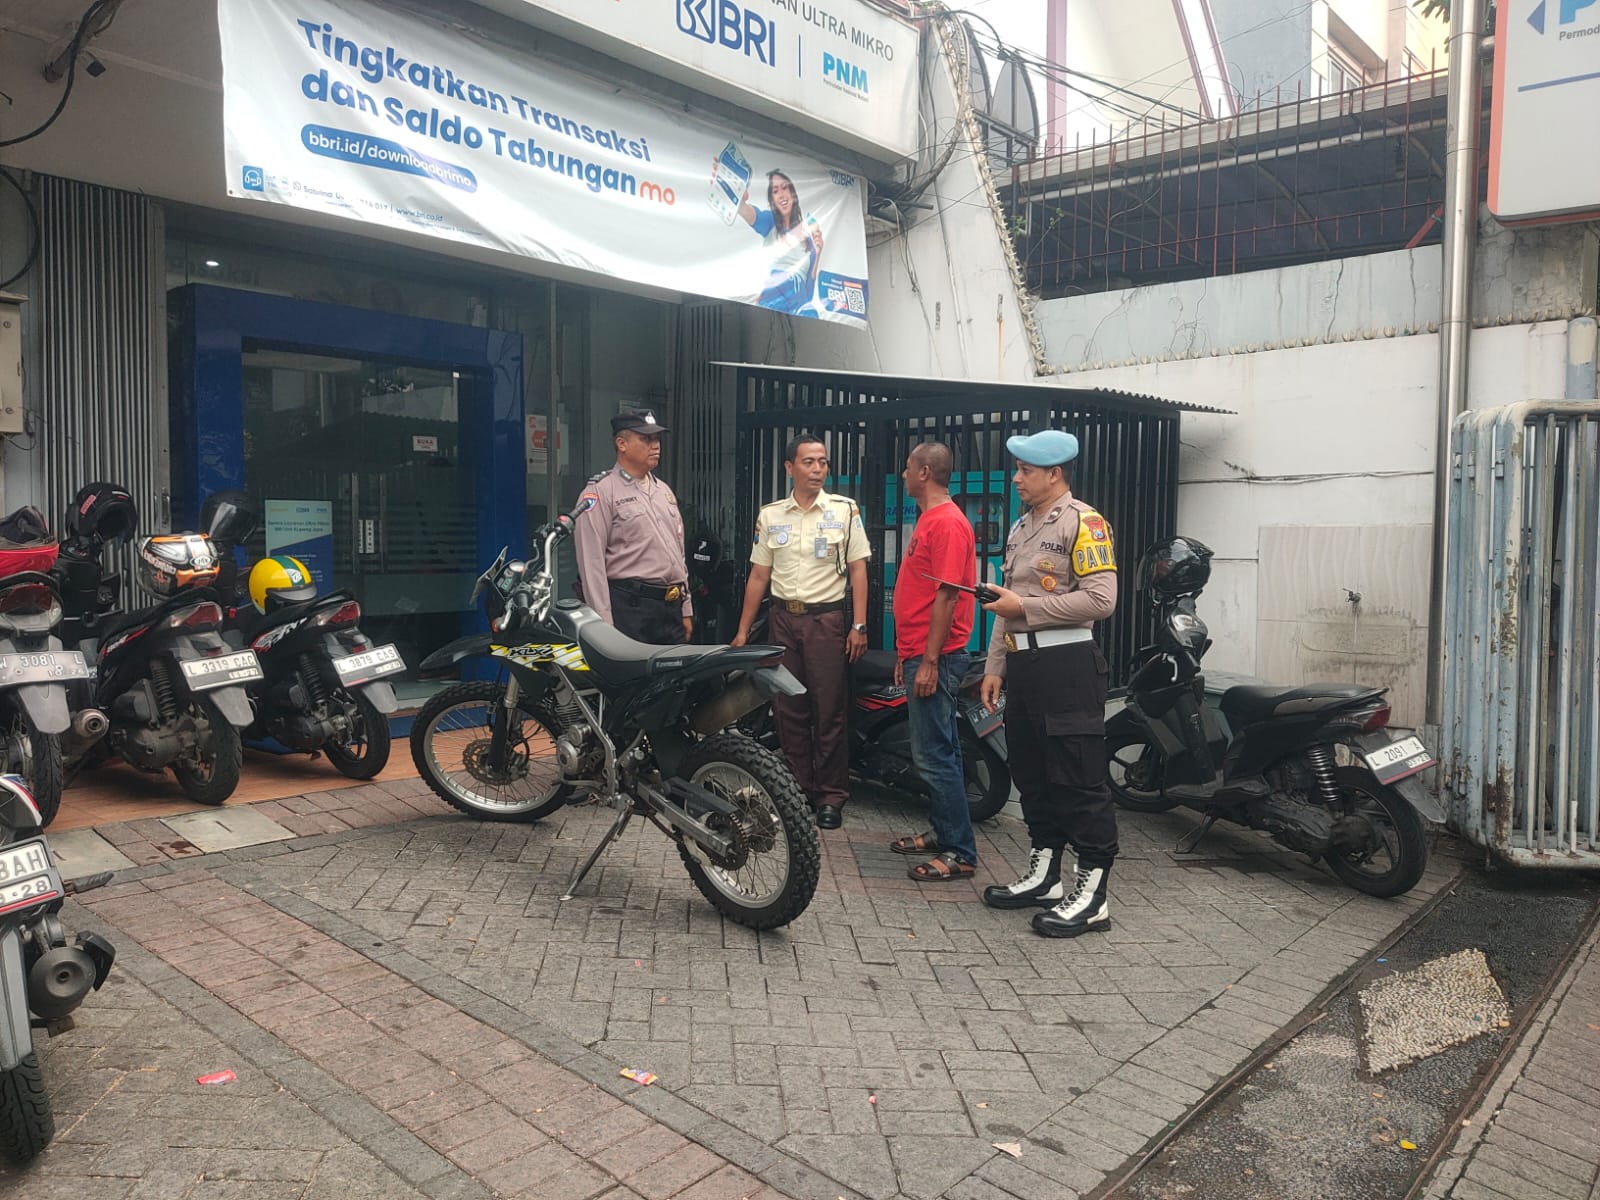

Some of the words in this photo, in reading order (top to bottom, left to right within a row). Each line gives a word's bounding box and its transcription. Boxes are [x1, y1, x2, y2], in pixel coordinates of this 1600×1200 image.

[719, 0, 776, 68] BRI
[803, 2, 847, 40] ULTRA
[851, 27, 894, 62] MIKRO
[823, 51, 869, 94] PNM
[297, 18, 510, 115] Tingkatkan
[511, 95, 652, 162] Transaksi
[301, 69, 378, 119] dan
[385, 97, 483, 150] Saldo
[489, 127, 637, 197] Tabungan
[640, 181, 676, 206] mo
[308, 131, 473, 188] bbri.id/downloadbrimo
[1040, 541, 1066, 555] POLRI
[20, 653, 56, 666] 3081
[74, 653, 83, 665] L
[338, 663, 346, 673] L
[508, 644, 554, 660] KLX
[187, 665, 198, 676] L
[1370, 756, 1381, 767] L
[1384, 745, 1408, 762] 2091
